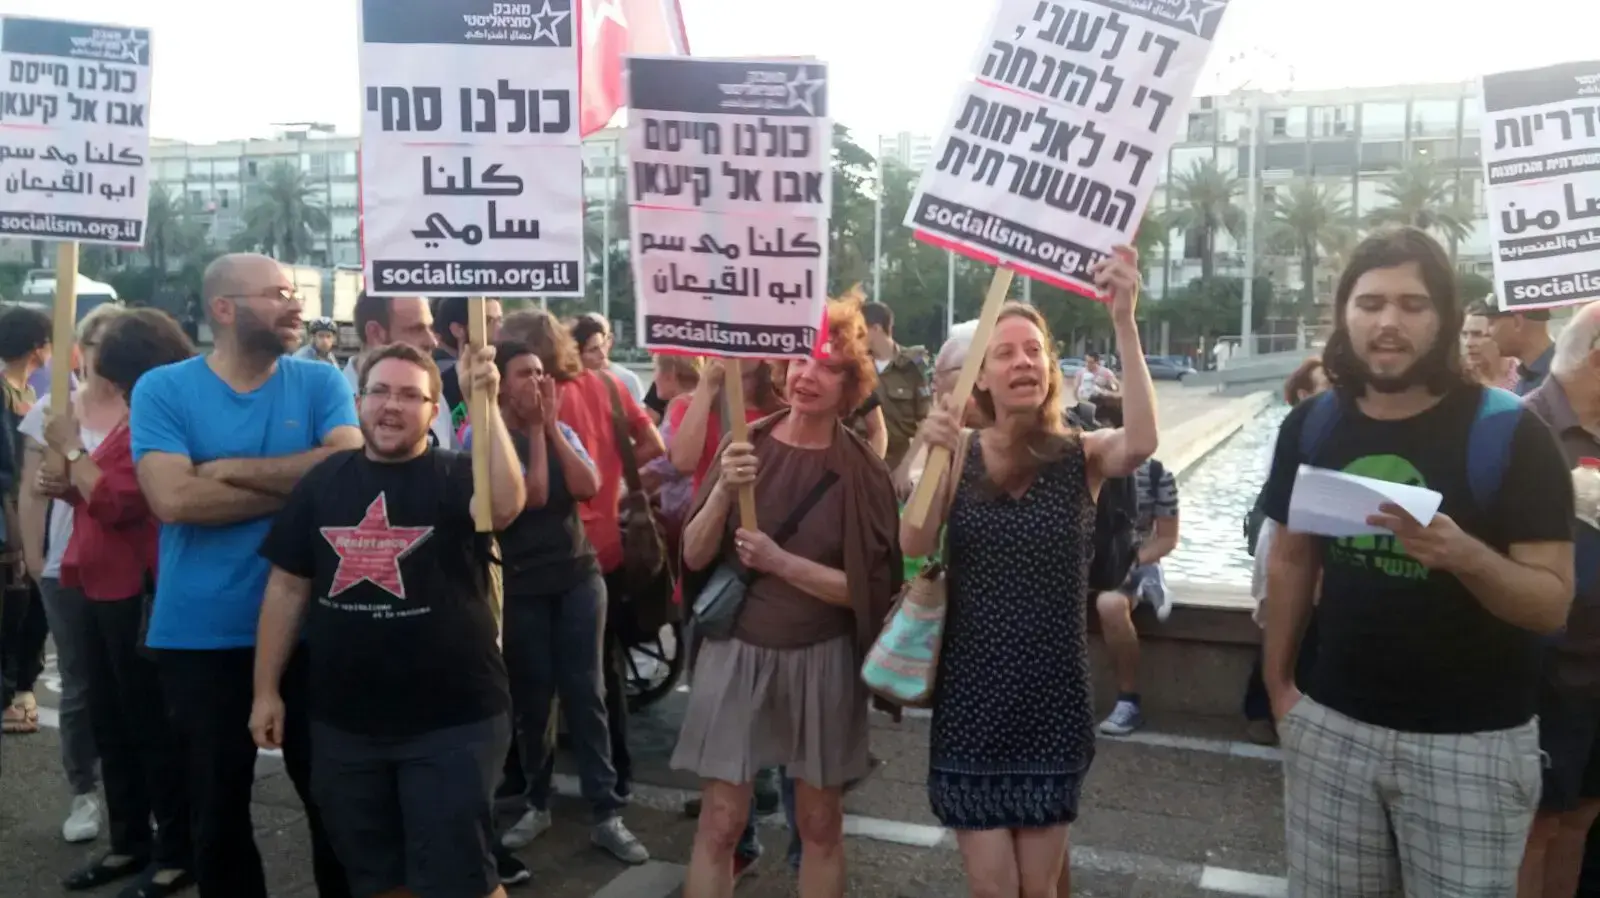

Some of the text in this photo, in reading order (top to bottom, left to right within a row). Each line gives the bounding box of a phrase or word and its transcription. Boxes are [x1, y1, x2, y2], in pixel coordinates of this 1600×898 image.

[463, 13, 532, 28] סוציאליסטי
[493, 3, 531, 16] מאבק
[1014, 1, 1180, 78] די לעוני,
[10, 60, 137, 94] כולנו מייסם
[980, 40, 1174, 133] די להזנחה
[67, 92, 98, 124] אל
[106, 100, 145, 127] אבו
[366, 79, 571, 134] כולנו סמי
[85, 140, 144, 167] كلنا
[643, 117, 812, 158] כולנו מייסם
[954, 94, 1154, 187] די לאלימות
[6, 168, 94, 198] القيعان
[423, 156, 524, 196] كلنا
[634, 160, 824, 206] אבו אל קיעאן
[936, 136, 1137, 233] המשטרתית
[1, 214, 137, 240] socialism.org.il
[411, 200, 540, 249] سامي
[748, 225, 822, 258] كلنا
[382, 264, 570, 290] socialism.org.il
[653, 262, 814, 305] ابو القيعان
[651, 319, 816, 350] socialism.org.il
